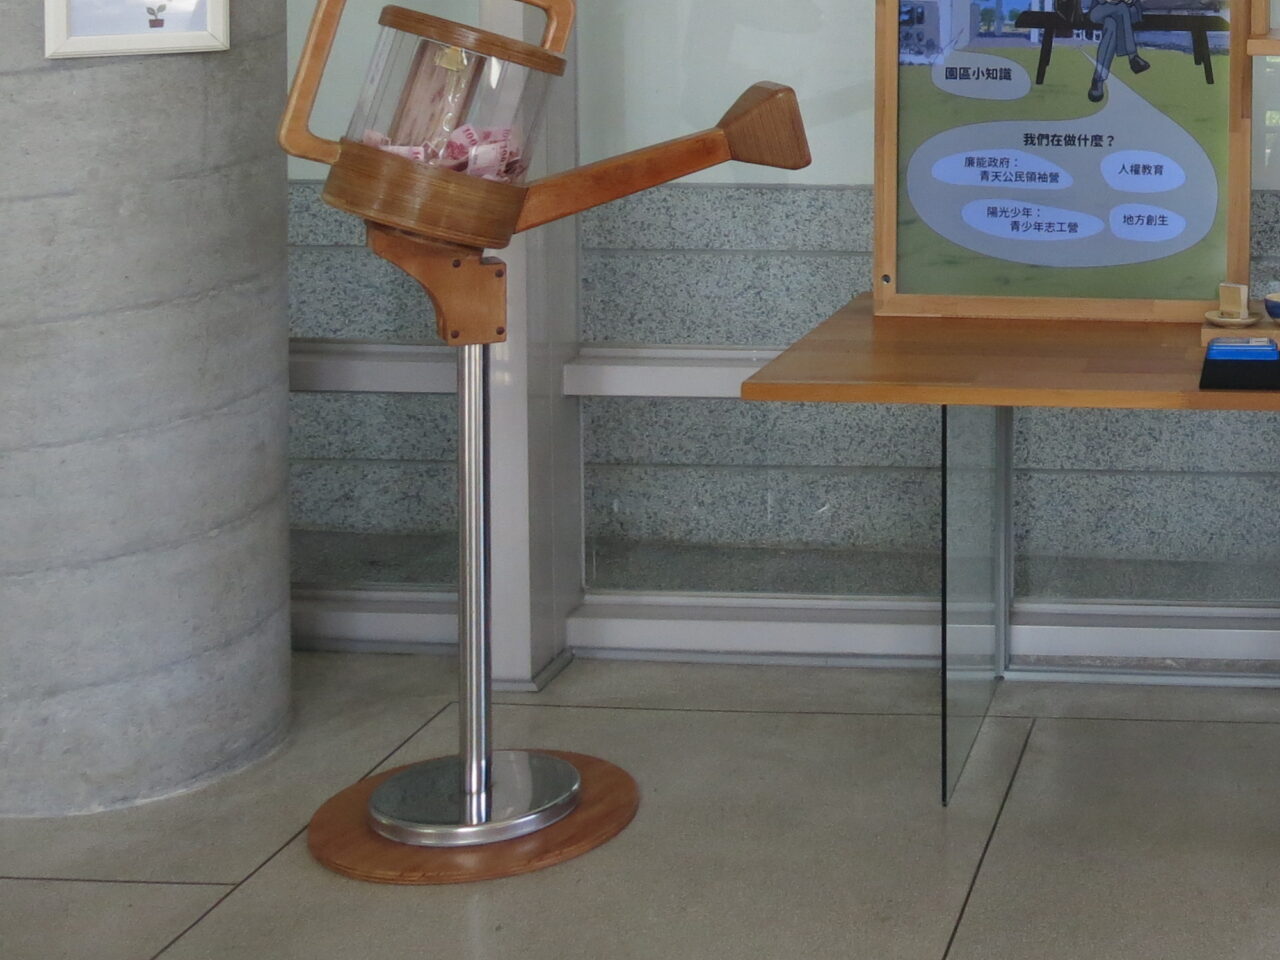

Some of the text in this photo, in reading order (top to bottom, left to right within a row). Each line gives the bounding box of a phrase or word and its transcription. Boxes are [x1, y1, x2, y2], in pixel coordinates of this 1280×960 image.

[945, 67, 1012, 81] 園區小知識
[1118, 163, 1164, 176] 人權教育
[979, 170, 1060, 184] 青天公民領袖營
[1122, 214, 1169, 227] 地方創生
[1010, 221, 1079, 234] 青少年志工營
